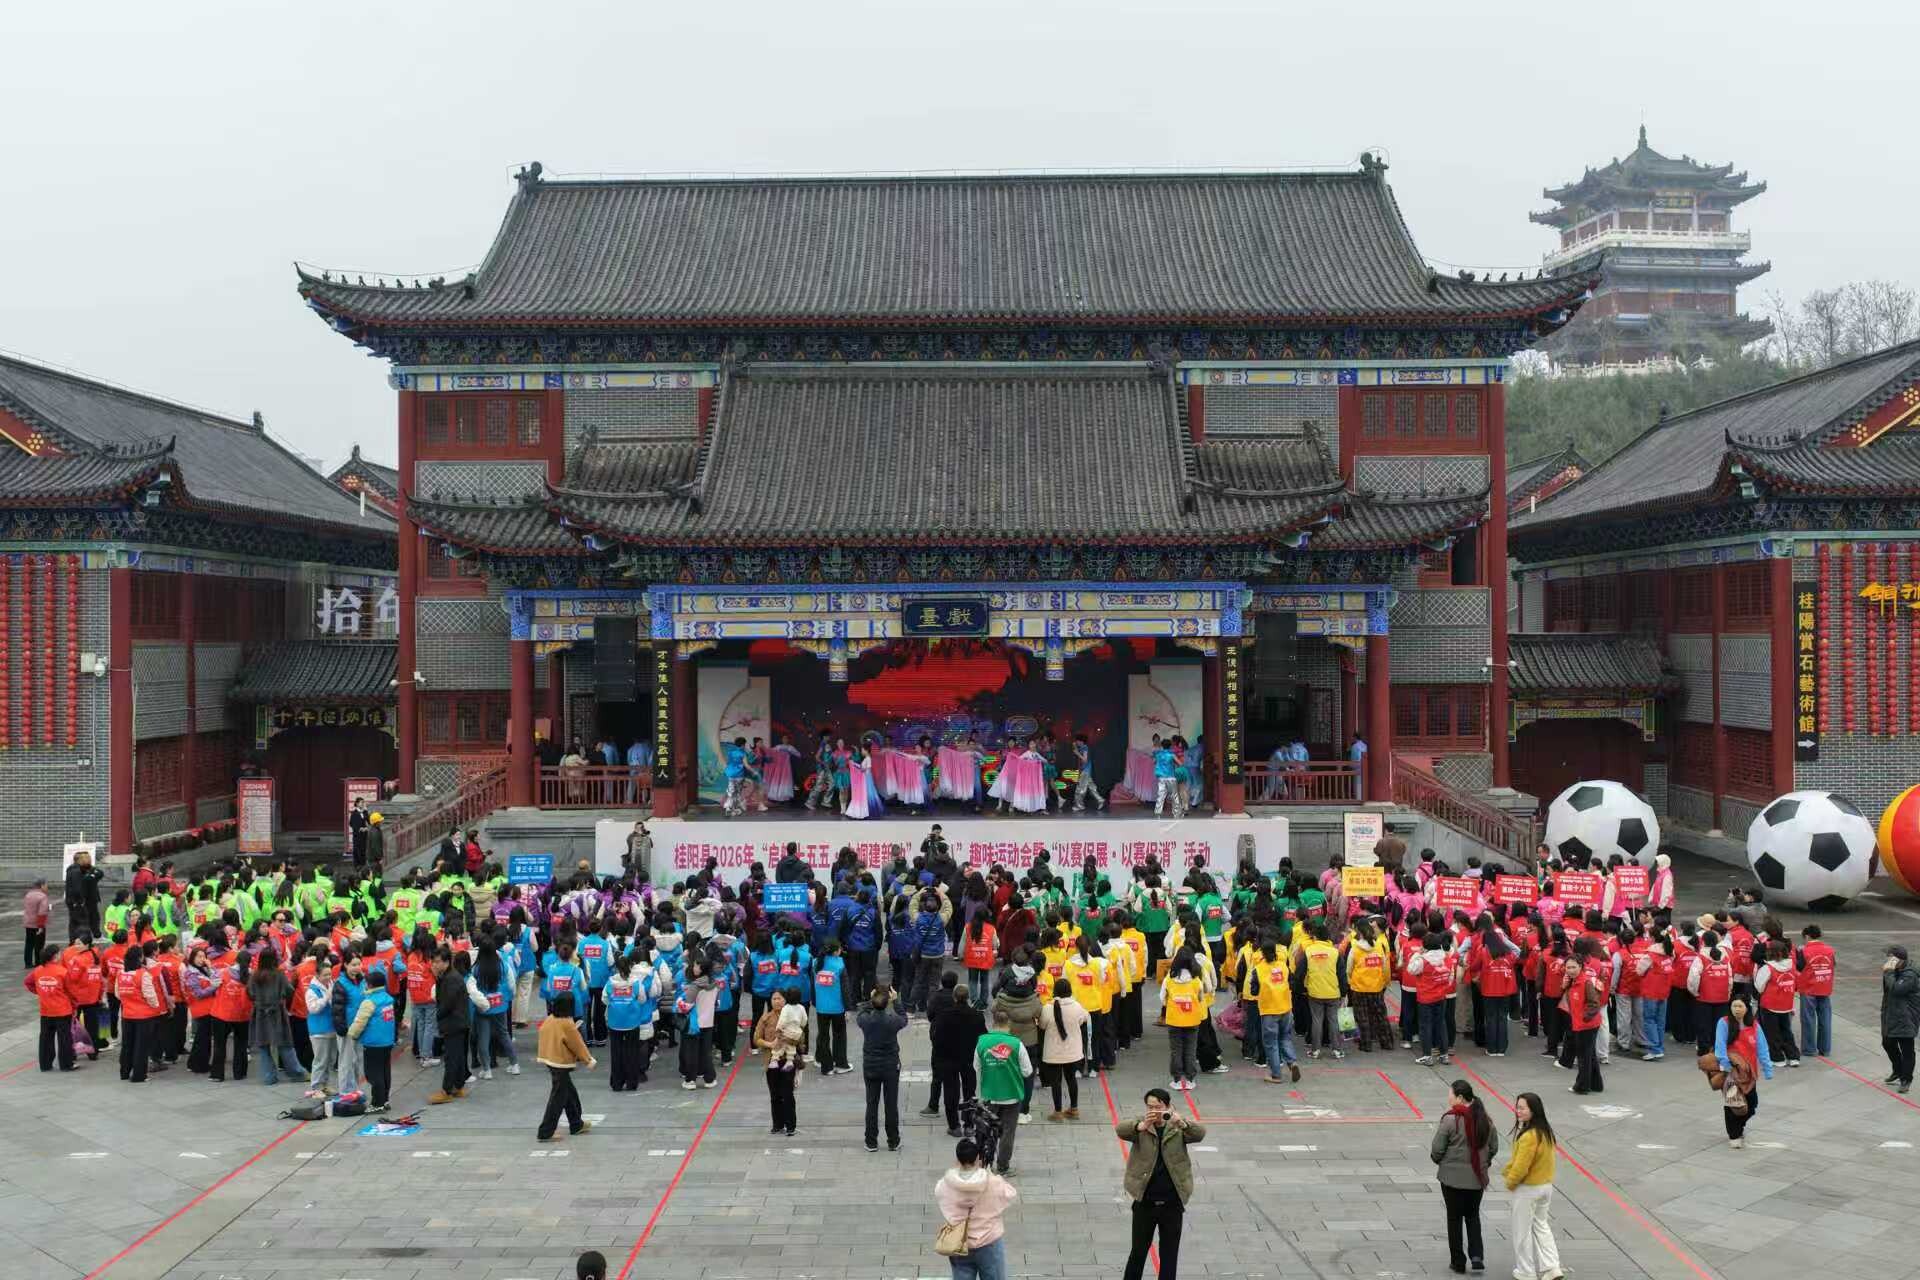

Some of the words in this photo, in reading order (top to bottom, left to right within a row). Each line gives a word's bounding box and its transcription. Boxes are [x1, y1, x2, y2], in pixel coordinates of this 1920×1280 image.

[1798, 592, 1816, 733] 桂陽賞石藝術館
